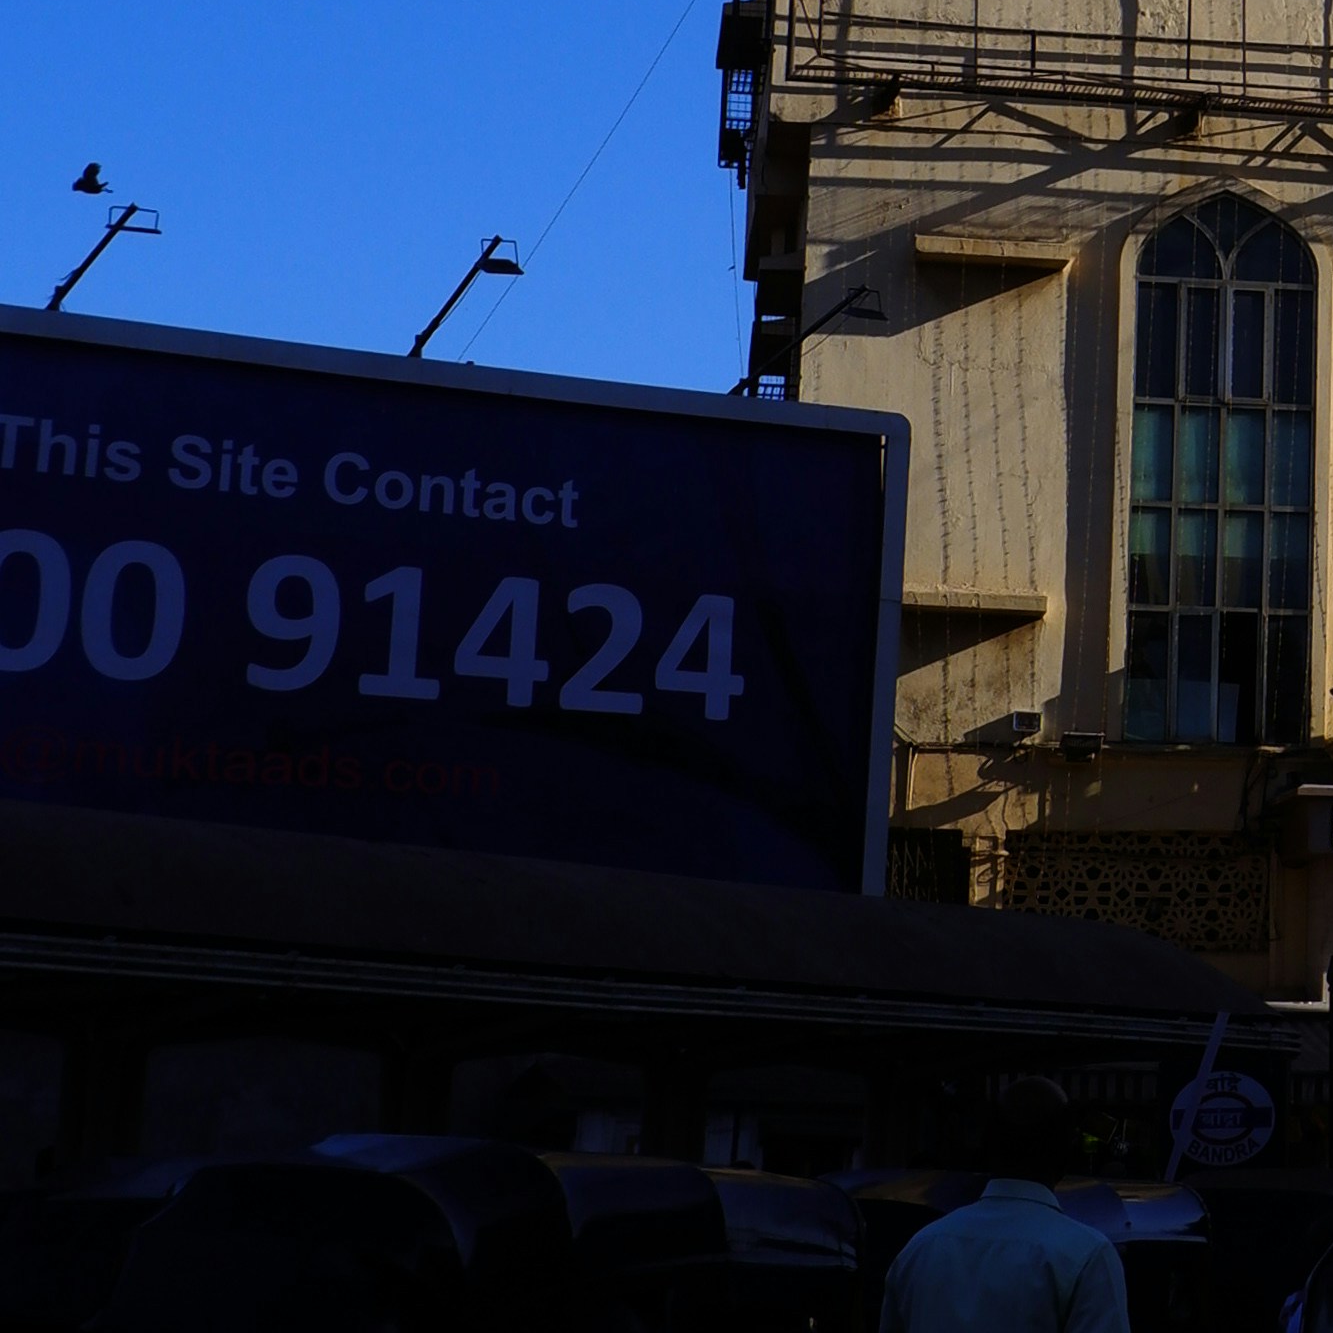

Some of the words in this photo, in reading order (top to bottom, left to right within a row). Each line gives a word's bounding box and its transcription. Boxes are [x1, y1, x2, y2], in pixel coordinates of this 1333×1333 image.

[0, 412, 141, 485] This
[167, 434, 299, 499] Site
[324, 450, 581, 529] Contact
[245, 554, 745, 722] 91424
[1187, 1137, 1261, 1163] BANDRA
